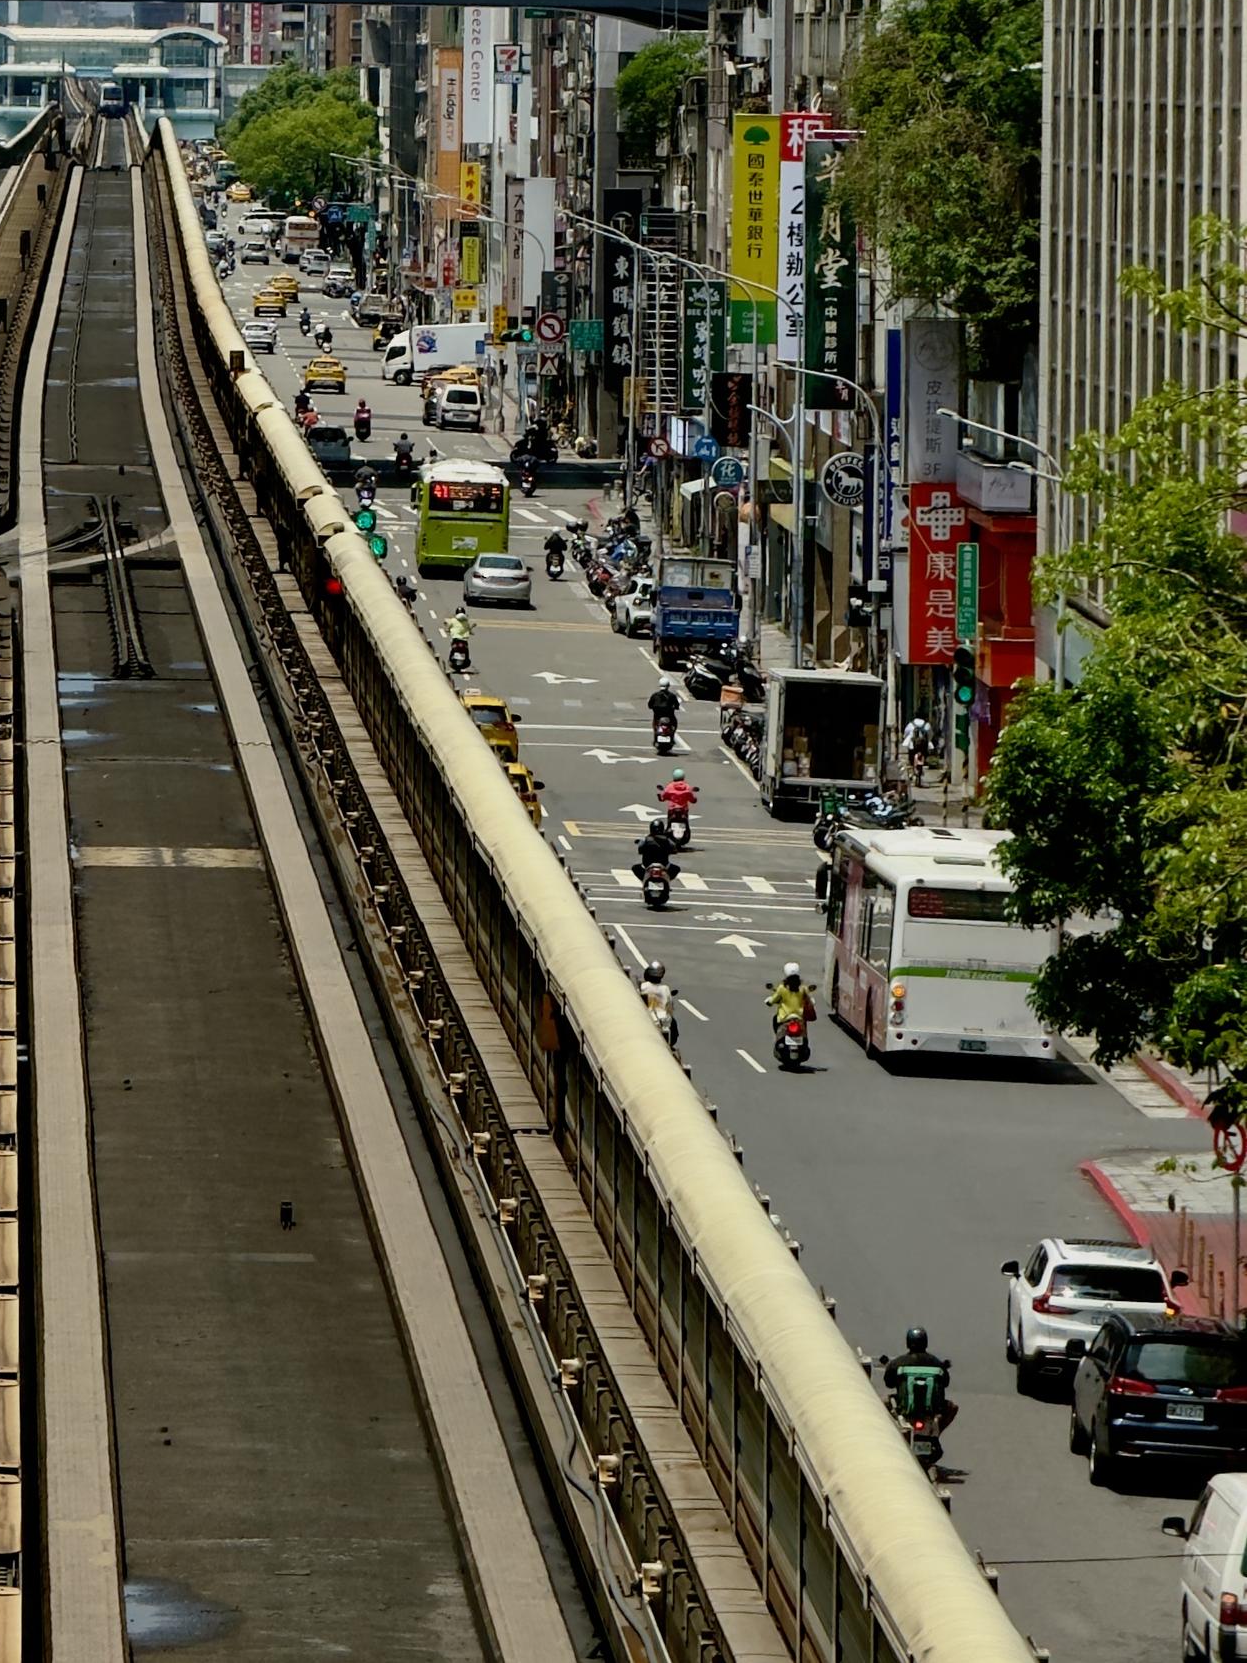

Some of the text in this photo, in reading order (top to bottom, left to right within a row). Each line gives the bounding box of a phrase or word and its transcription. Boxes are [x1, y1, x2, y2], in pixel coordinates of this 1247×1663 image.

[442, 77, 457, 120] Holiday
[471, 50, 484, 103] Center
[747, 153, 765, 259] 國泰世華銀行
[924, 379, 944, 454] 皮拉提斯
[720, 460, 736, 477] 花
[830, 456, 865, 472] PERFEC
[923, 462, 943, 477] 3F
[924, 551, 957, 657] 康是美
